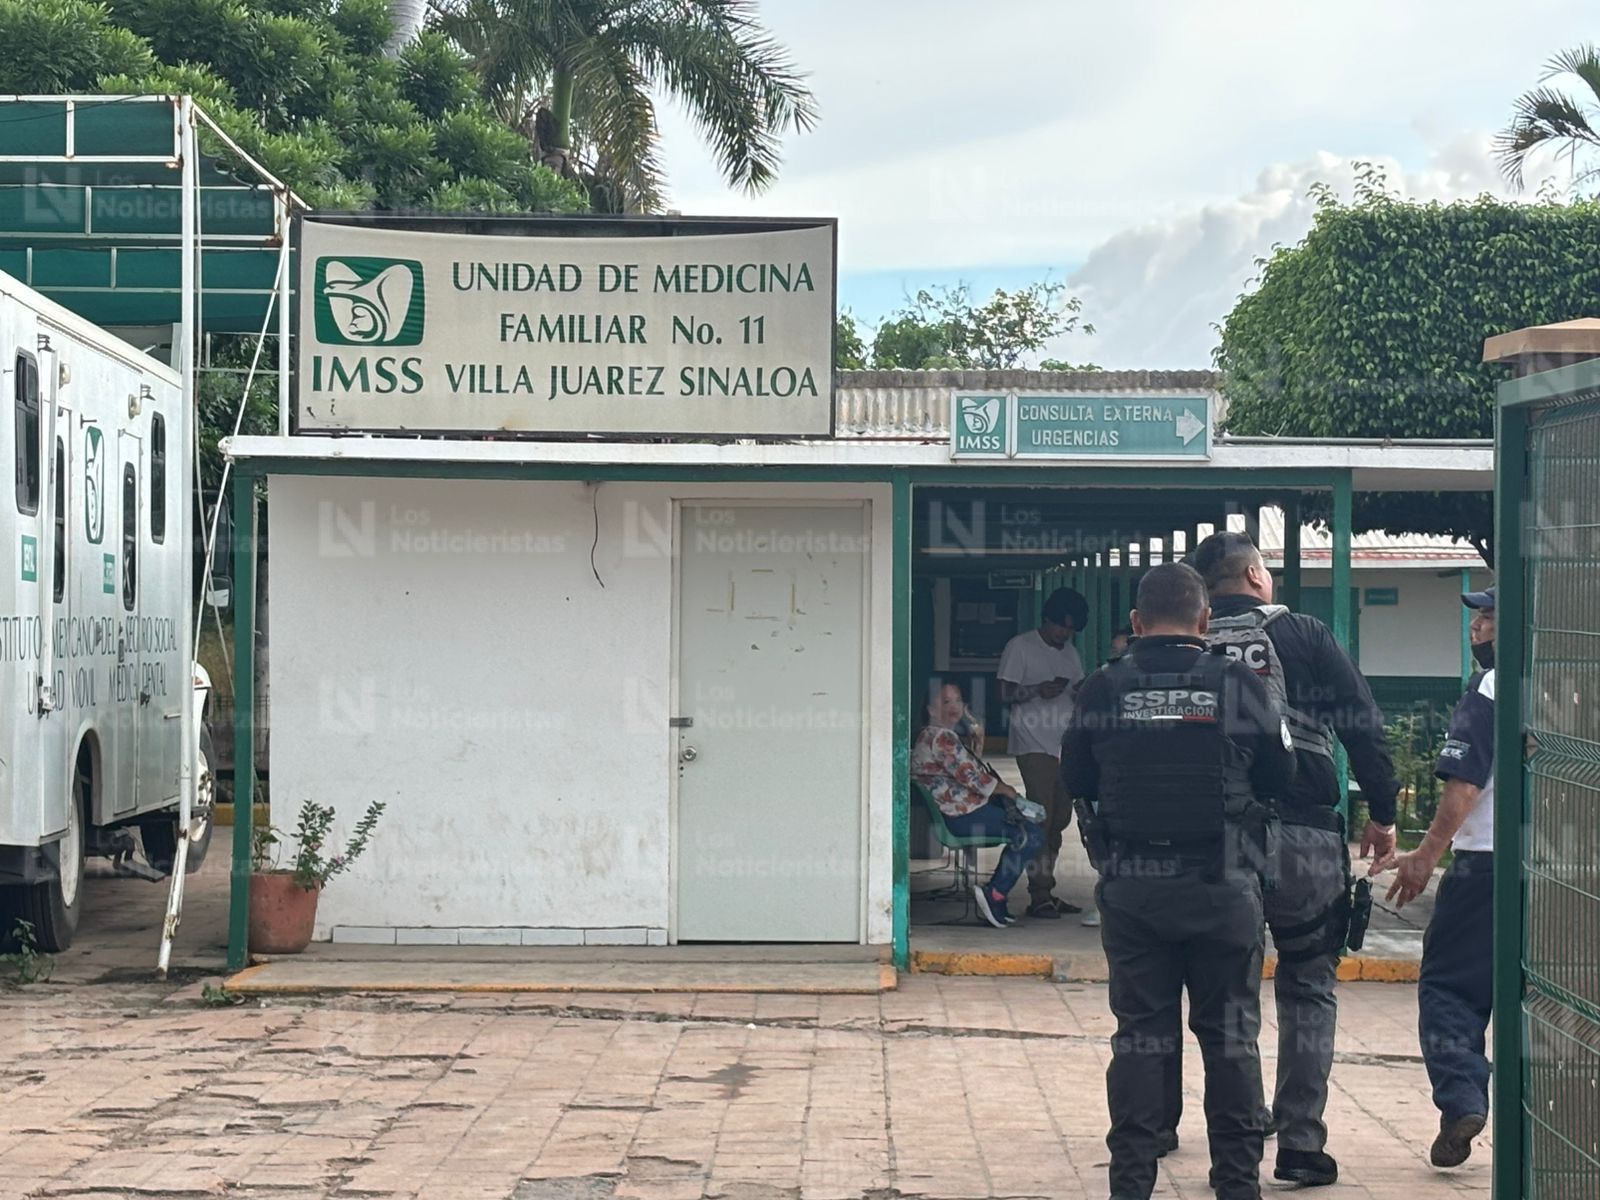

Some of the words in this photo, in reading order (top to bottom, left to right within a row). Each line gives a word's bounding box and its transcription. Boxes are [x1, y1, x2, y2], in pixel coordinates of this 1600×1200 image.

[453, 262, 582, 292] UNIDAD
[599, 264, 638, 292] DE
[653, 262, 815, 293] MEDICINA
[500, 313, 647, 344] FAMILIAR
[672, 315, 722, 345] No.
[739, 315, 765, 344] 11
[313, 355, 424, 394] IMSS
[445, 364, 534, 394] VILLA
[549, 365, 665, 400] JUAREZ
[680, 366, 818, 397] SINALOA
[1020, 405, 1094, 422] CONSULTA
[1104, 405, 1173, 422] EXTERNA
[960, 436, 1000, 450] IMSS
[1032, 430, 1119, 446] URGENCIAS
[102, 616, 116, 655] DEL
[27, 671, 65, 715] UNAD
[1124, 690, 1214, 711] SSPC
